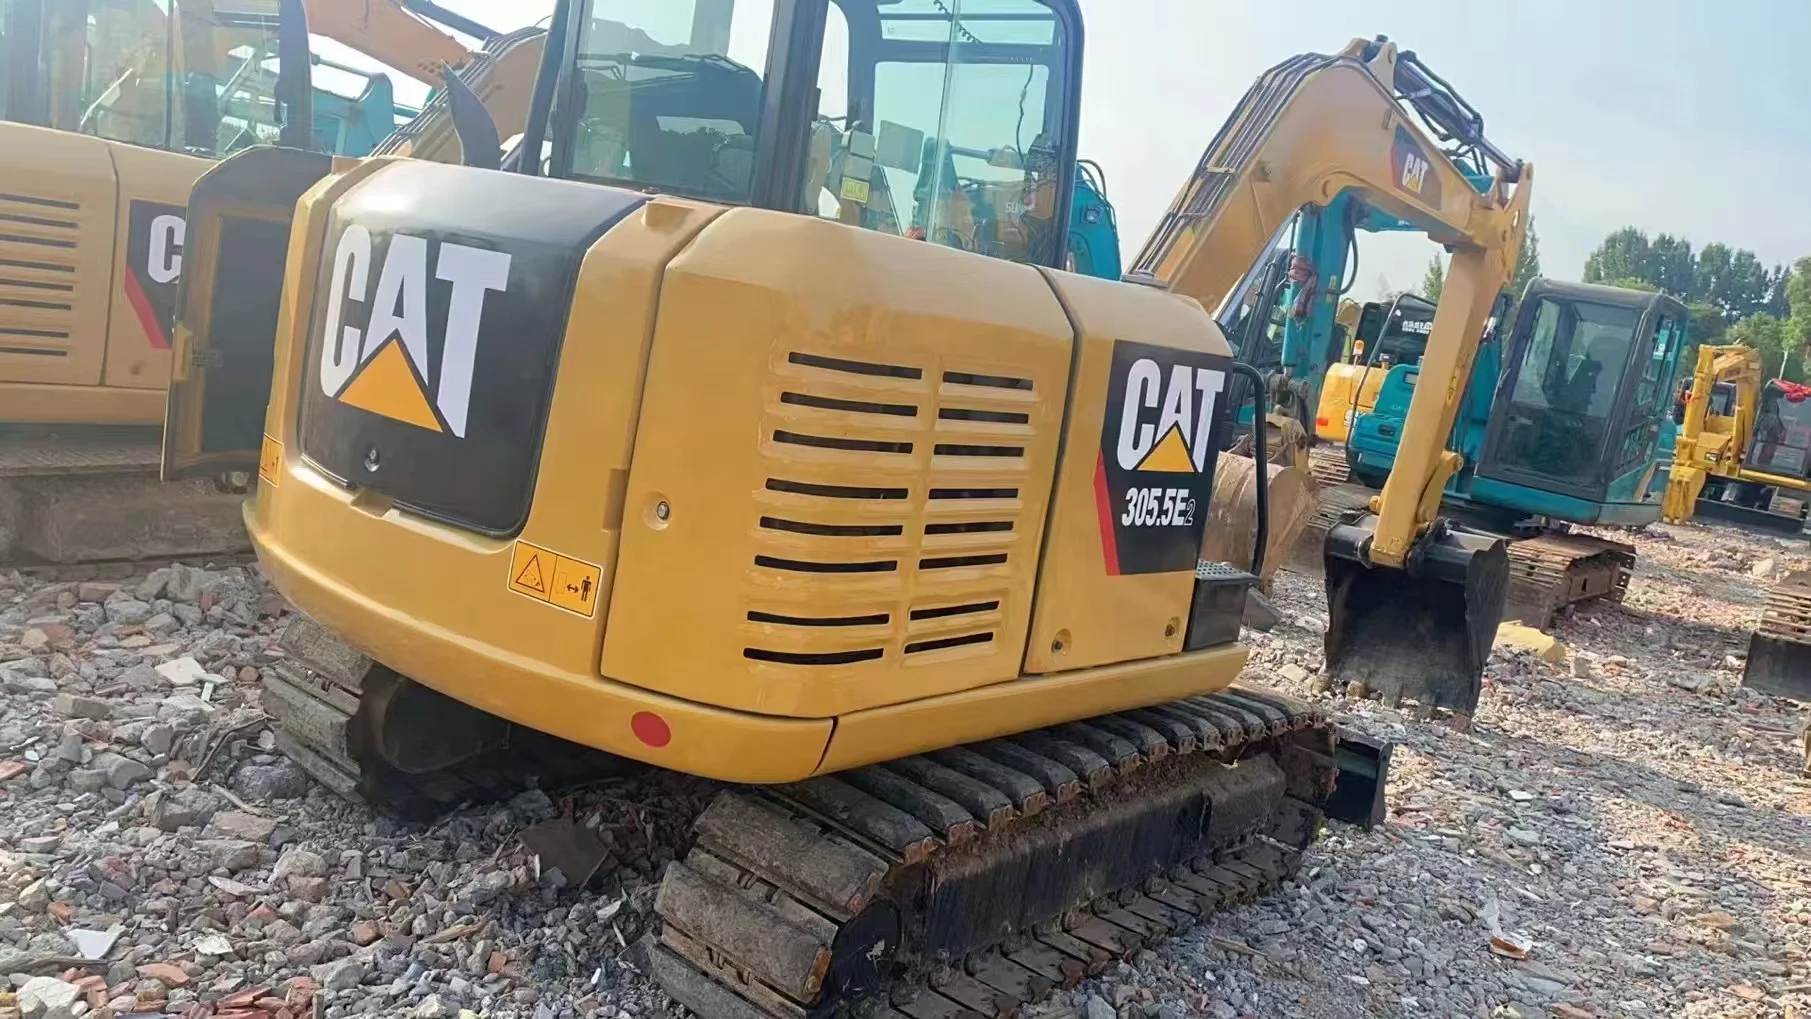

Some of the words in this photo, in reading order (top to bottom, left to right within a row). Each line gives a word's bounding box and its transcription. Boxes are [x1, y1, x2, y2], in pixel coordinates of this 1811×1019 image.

[1402, 152, 1429, 194] CAT
[320, 224, 512, 439] CAT
[1117, 358, 1225, 473] CAT
